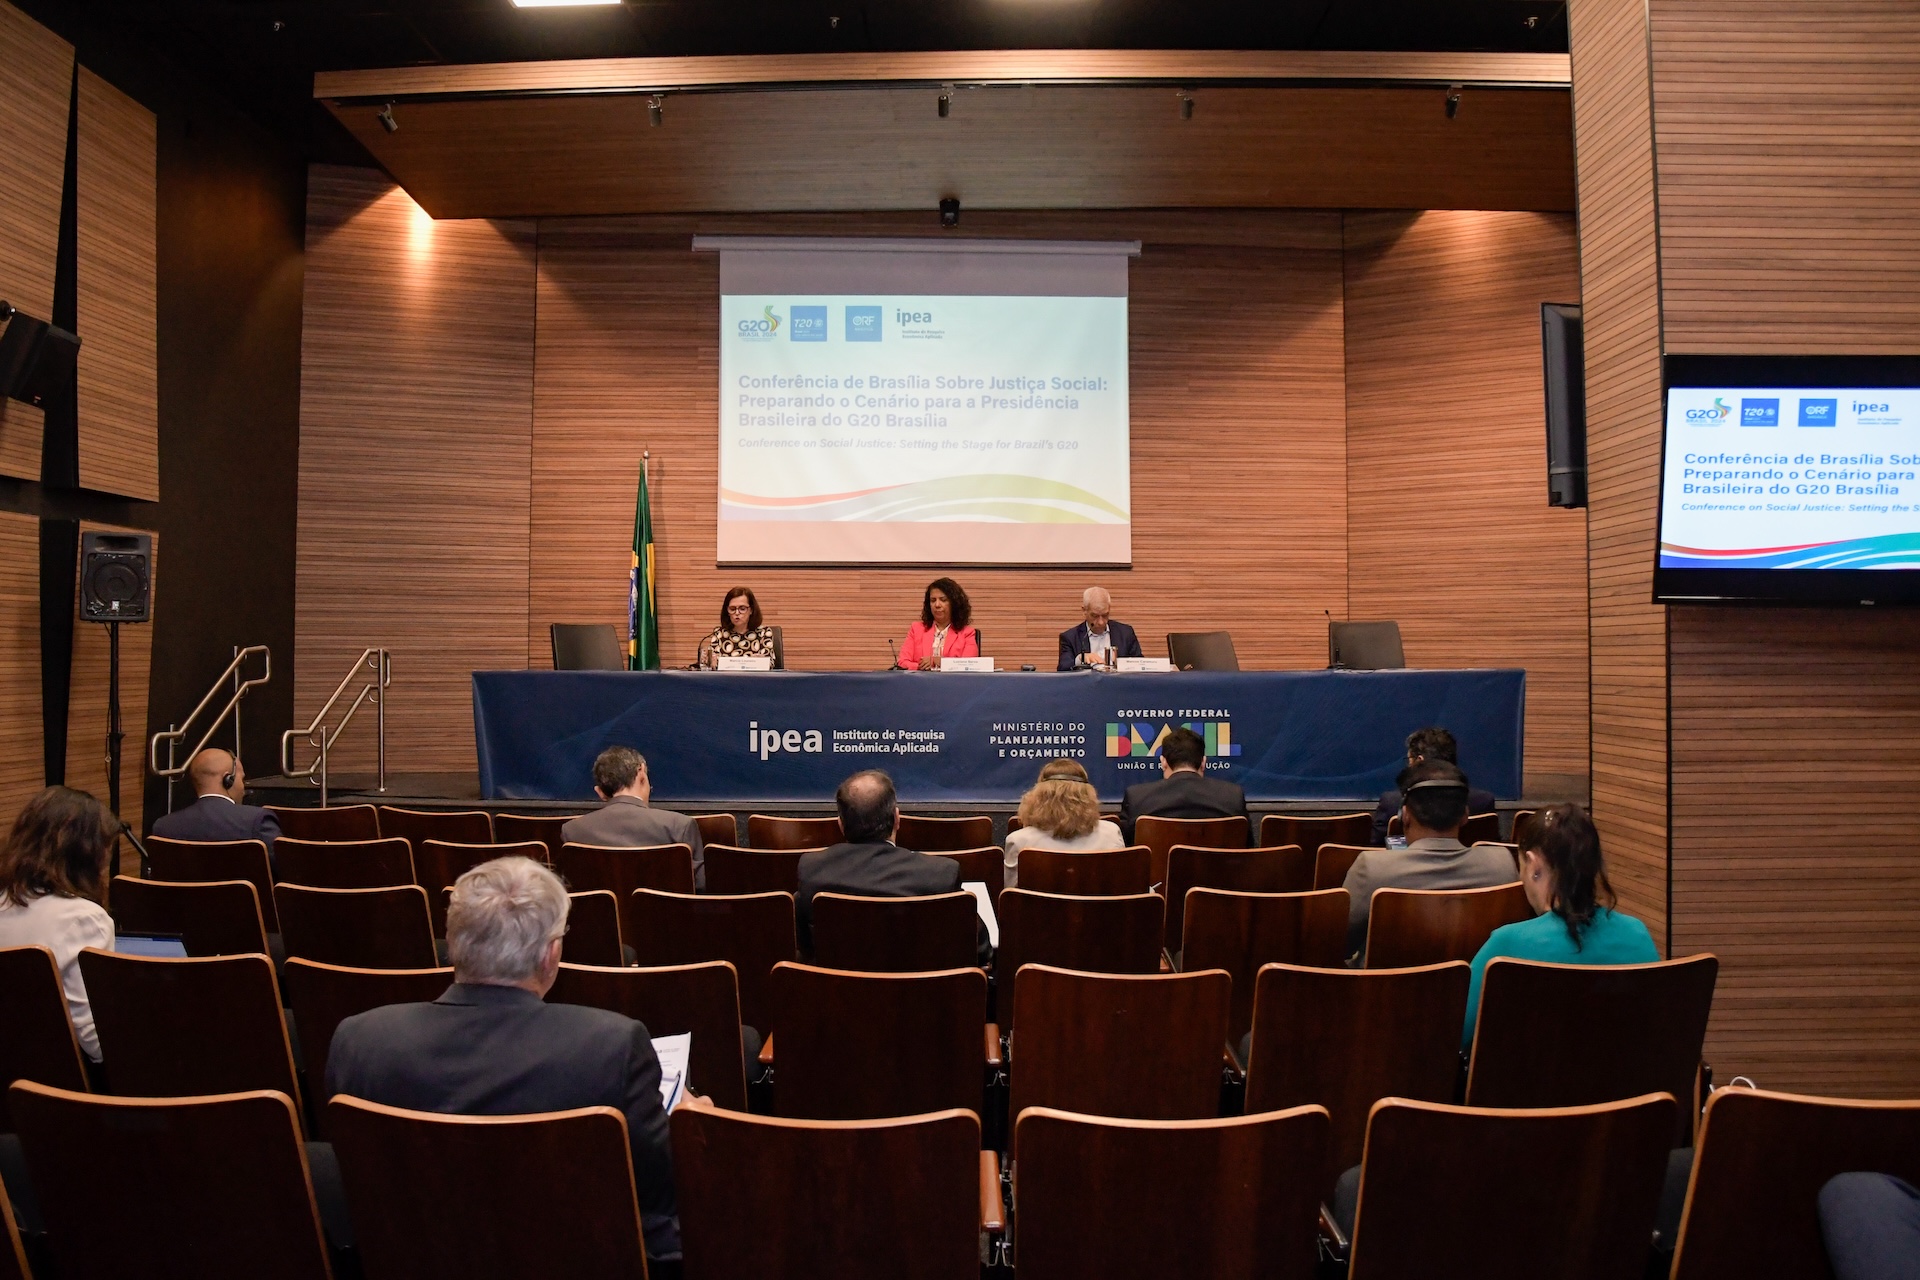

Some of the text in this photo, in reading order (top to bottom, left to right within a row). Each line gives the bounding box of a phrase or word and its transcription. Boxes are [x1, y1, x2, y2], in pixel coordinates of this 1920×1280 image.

[853, 316, 874, 326] ORF
[896, 309, 932, 326] ipea
[738, 320, 769, 331] G20
[794, 319, 812, 328] T20
[739, 375, 1108, 394] Conferência de Brasília Sobre Justiça Social:
[739, 394, 1079, 411] Preparando o Cenário para a Presidência
[1853, 401, 1889, 415] ipea
[1686, 410, 1718, 419] G20
[1744, 408, 1764, 416] T20
[1805, 406, 1829, 415] ORF
[739, 413, 948, 428] Brasileira do G20 Brasília
[738, 438, 800, 448] Conference
[803, 440, 816, 448] on
[819, 438, 853, 448] Social
[856, 438, 896, 449] Justice:
[899, 440, 938, 451] Setting
[941, 440, 958, 449] the
[962, 440, 993, 452] Stage
[996, 440, 1011, 450] for
[1056, 441, 1078, 450] G20
[1685, 454, 1788, 464] Conferência
[1794, 454, 1814, 464] de
[1820, 454, 1883, 464] Brasília
[1684, 468, 1914, 482] Preparando o Cenário para
[1683, 484, 1899, 495] Brasileira do G20 Brasília
[1849, 504, 1888, 513] Setting
[993, 721, 1085, 731] MINISTÉRIO DO
[749, 721, 823, 760] ipea
[833, 730, 945, 742] Instituto de Pesquisa
[990, 736, 1085, 744] PLANEJAMENTO
[833, 742, 939, 754] Econômica Aplicada
[1010, 749, 1085, 759] ORÇAMENTO
